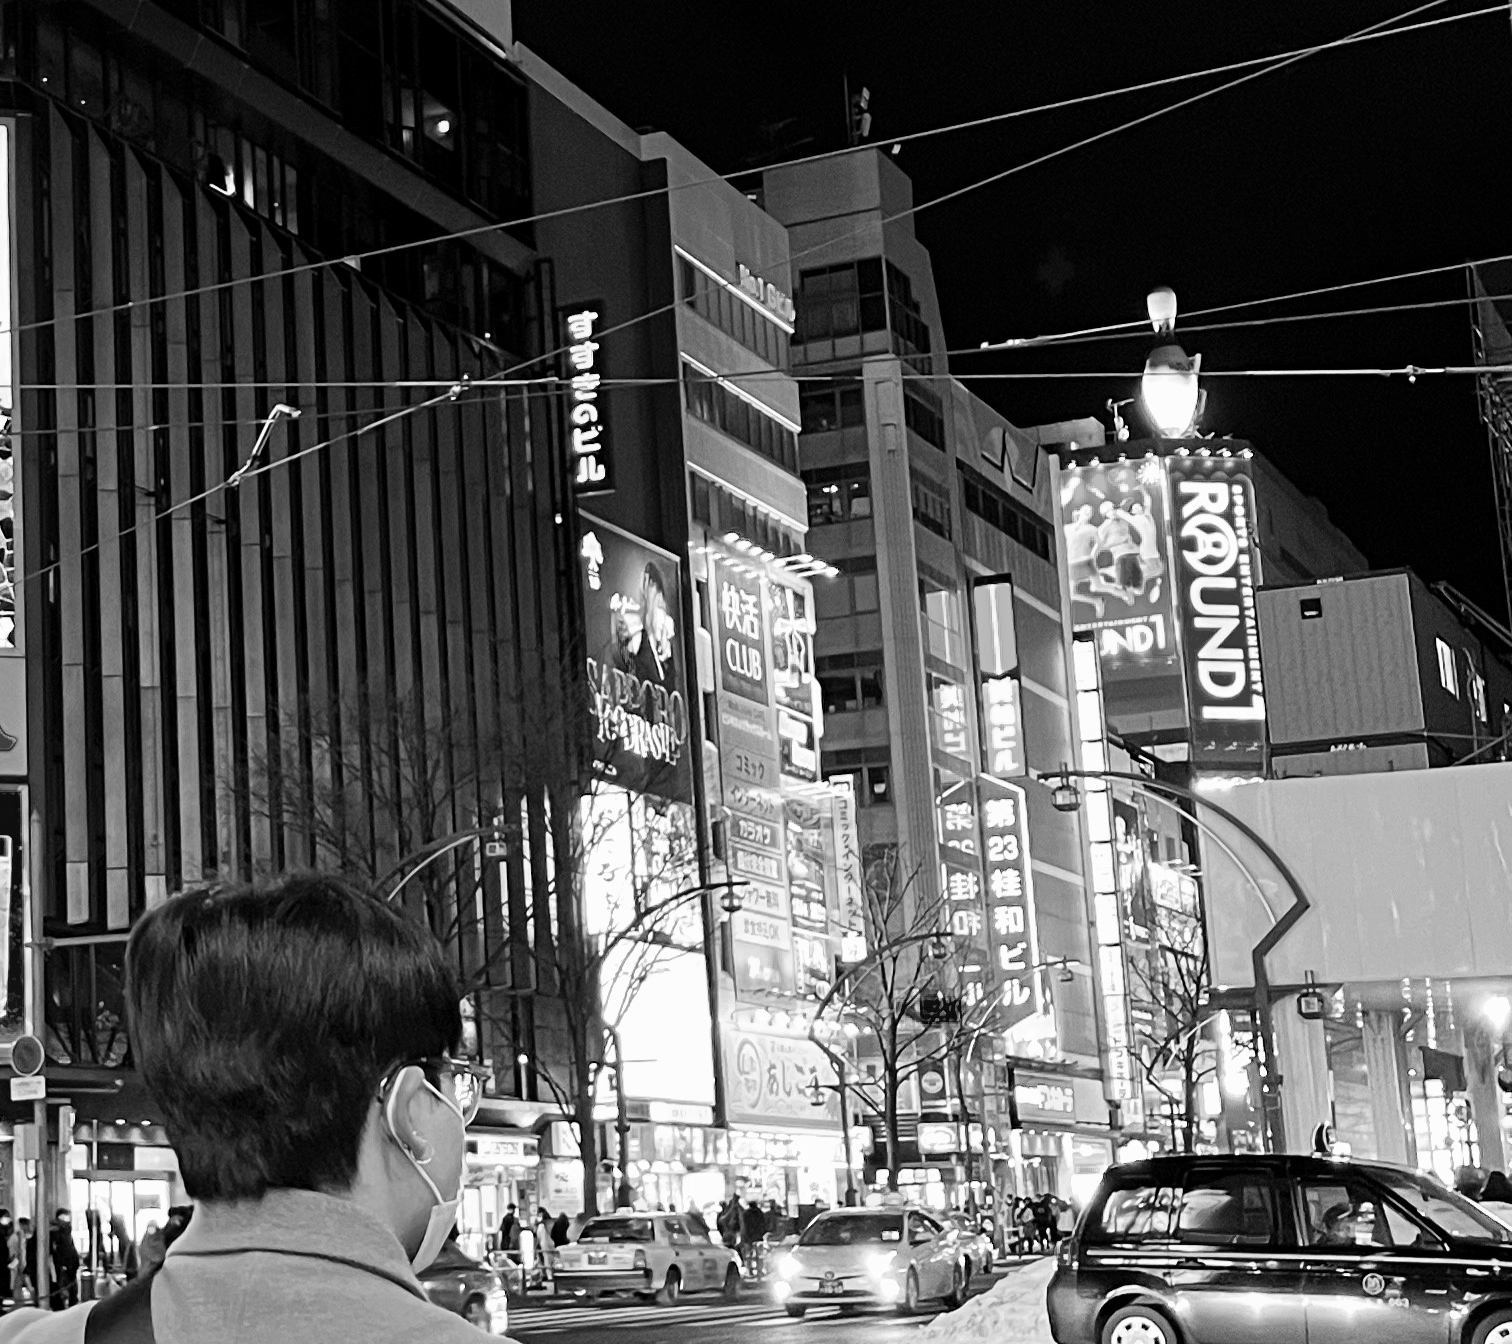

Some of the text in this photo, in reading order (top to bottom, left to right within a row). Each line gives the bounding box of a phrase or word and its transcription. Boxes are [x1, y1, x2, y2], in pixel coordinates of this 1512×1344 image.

[721, 580, 760, 641] 快活
[1179, 481, 1266, 721] ROUND1
[726, 637, 762, 682] CLUB
[735, 754, 765, 780] コミック
[986, 798, 1031, 1007] 第23桂和ビル
